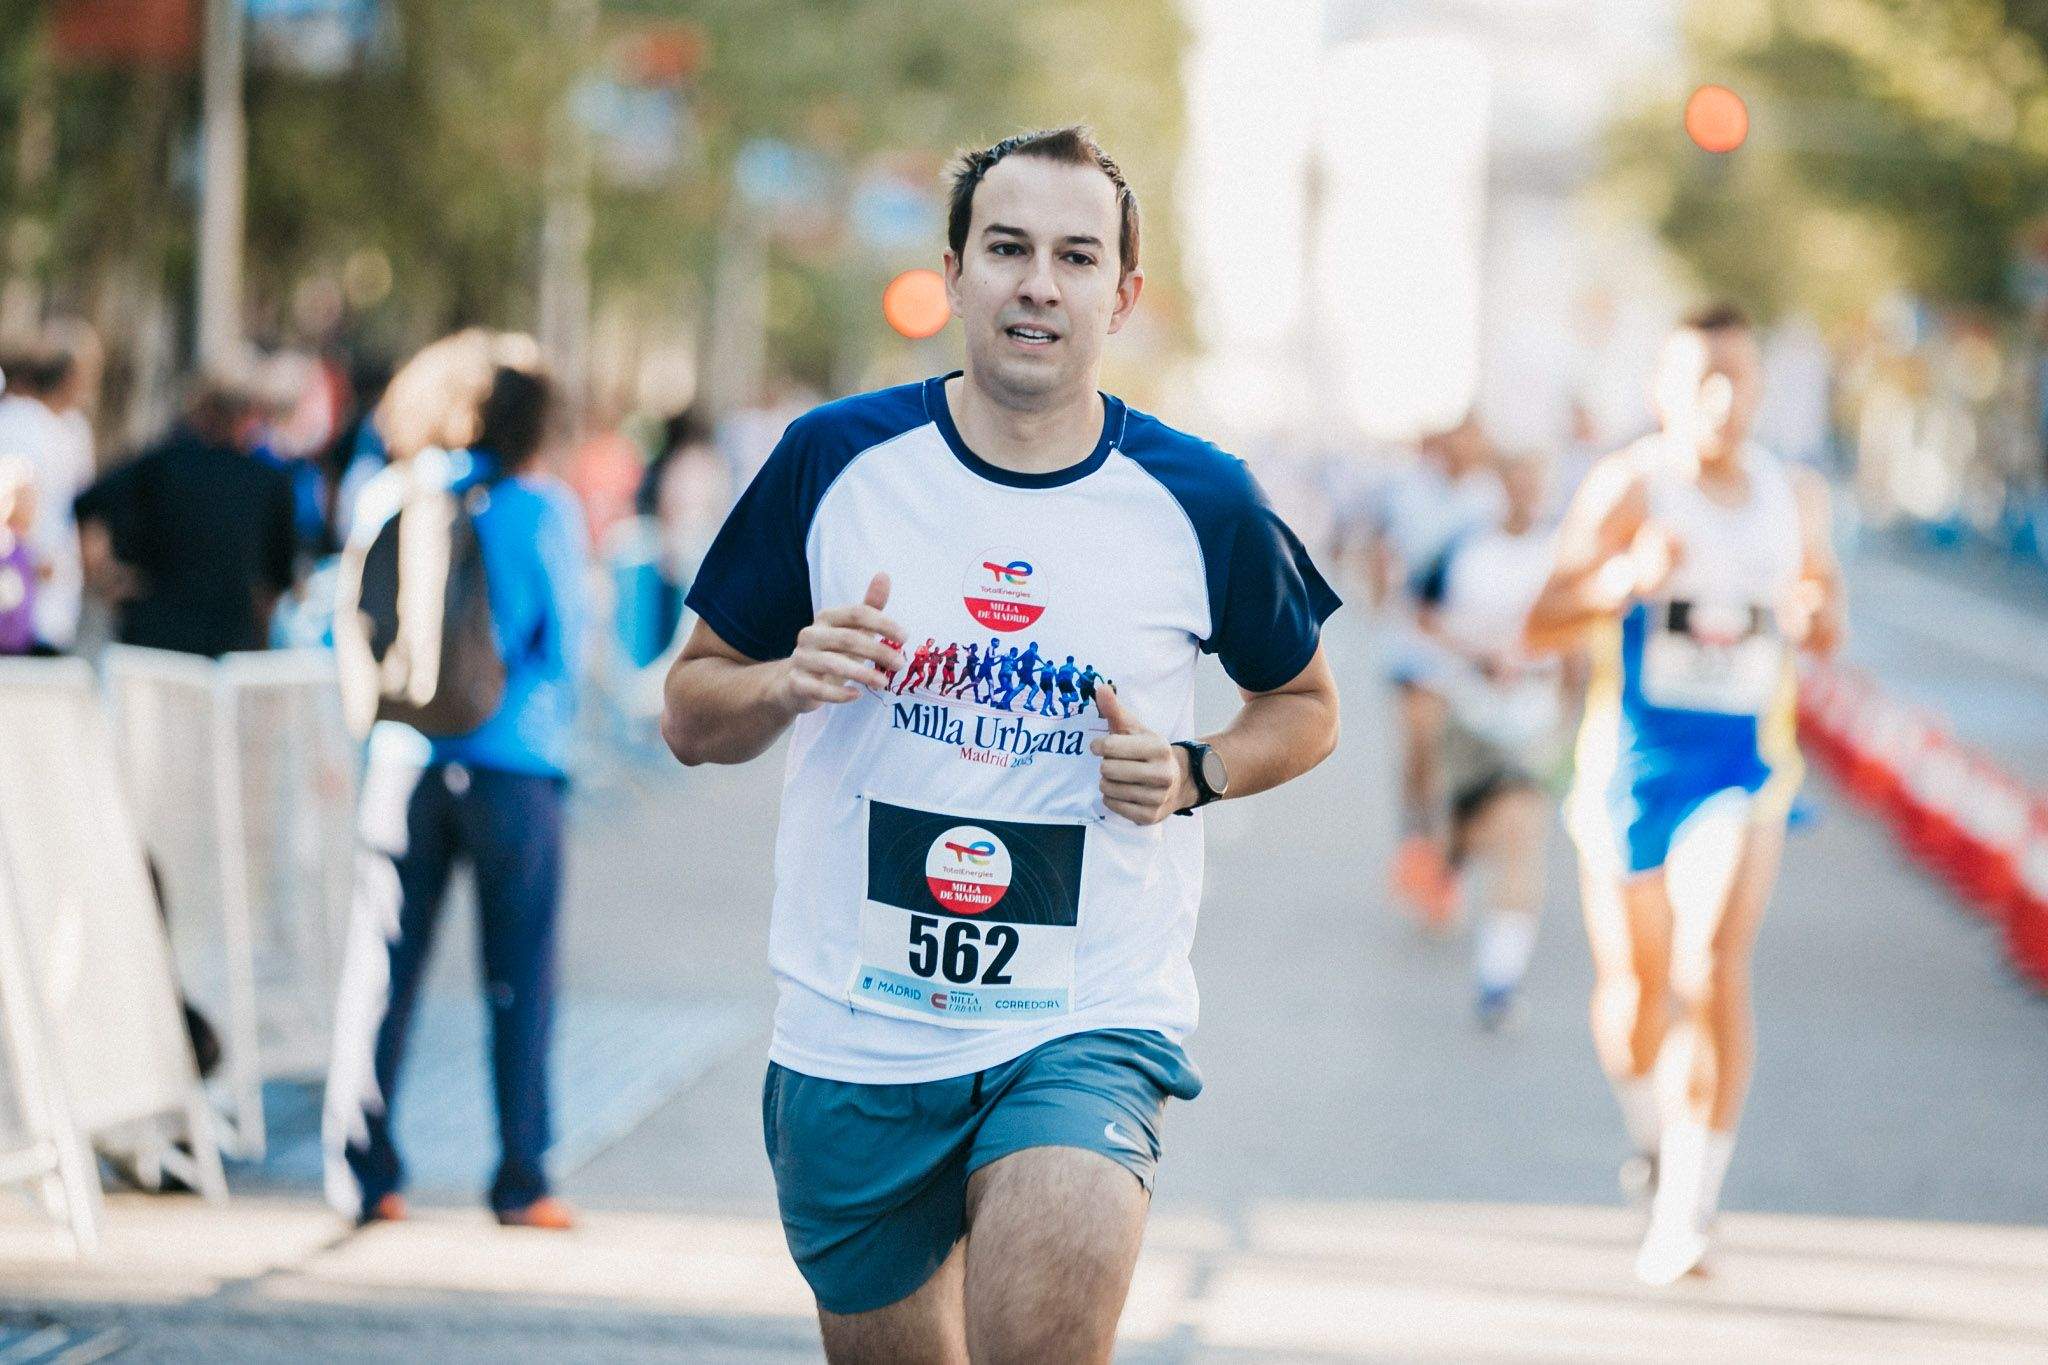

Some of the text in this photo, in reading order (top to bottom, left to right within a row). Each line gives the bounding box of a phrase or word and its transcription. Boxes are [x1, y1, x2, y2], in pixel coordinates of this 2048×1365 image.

[981, 585, 1031, 598] TotalEnergies
[990, 602, 1019, 613] MILLA
[977, 610, 1030, 624] DE MADRID
[893, 702, 1084, 756] Milla Urbana
[960, 747, 1009, 768] Madrid
[943, 866, 993, 878] TotalEnergies
[952, 882, 981, 894] MILLA
[940, 890, 992, 904] DE MADRID
[908, 914, 1020, 985] 562
[877, 981, 922, 1000] MADRID
